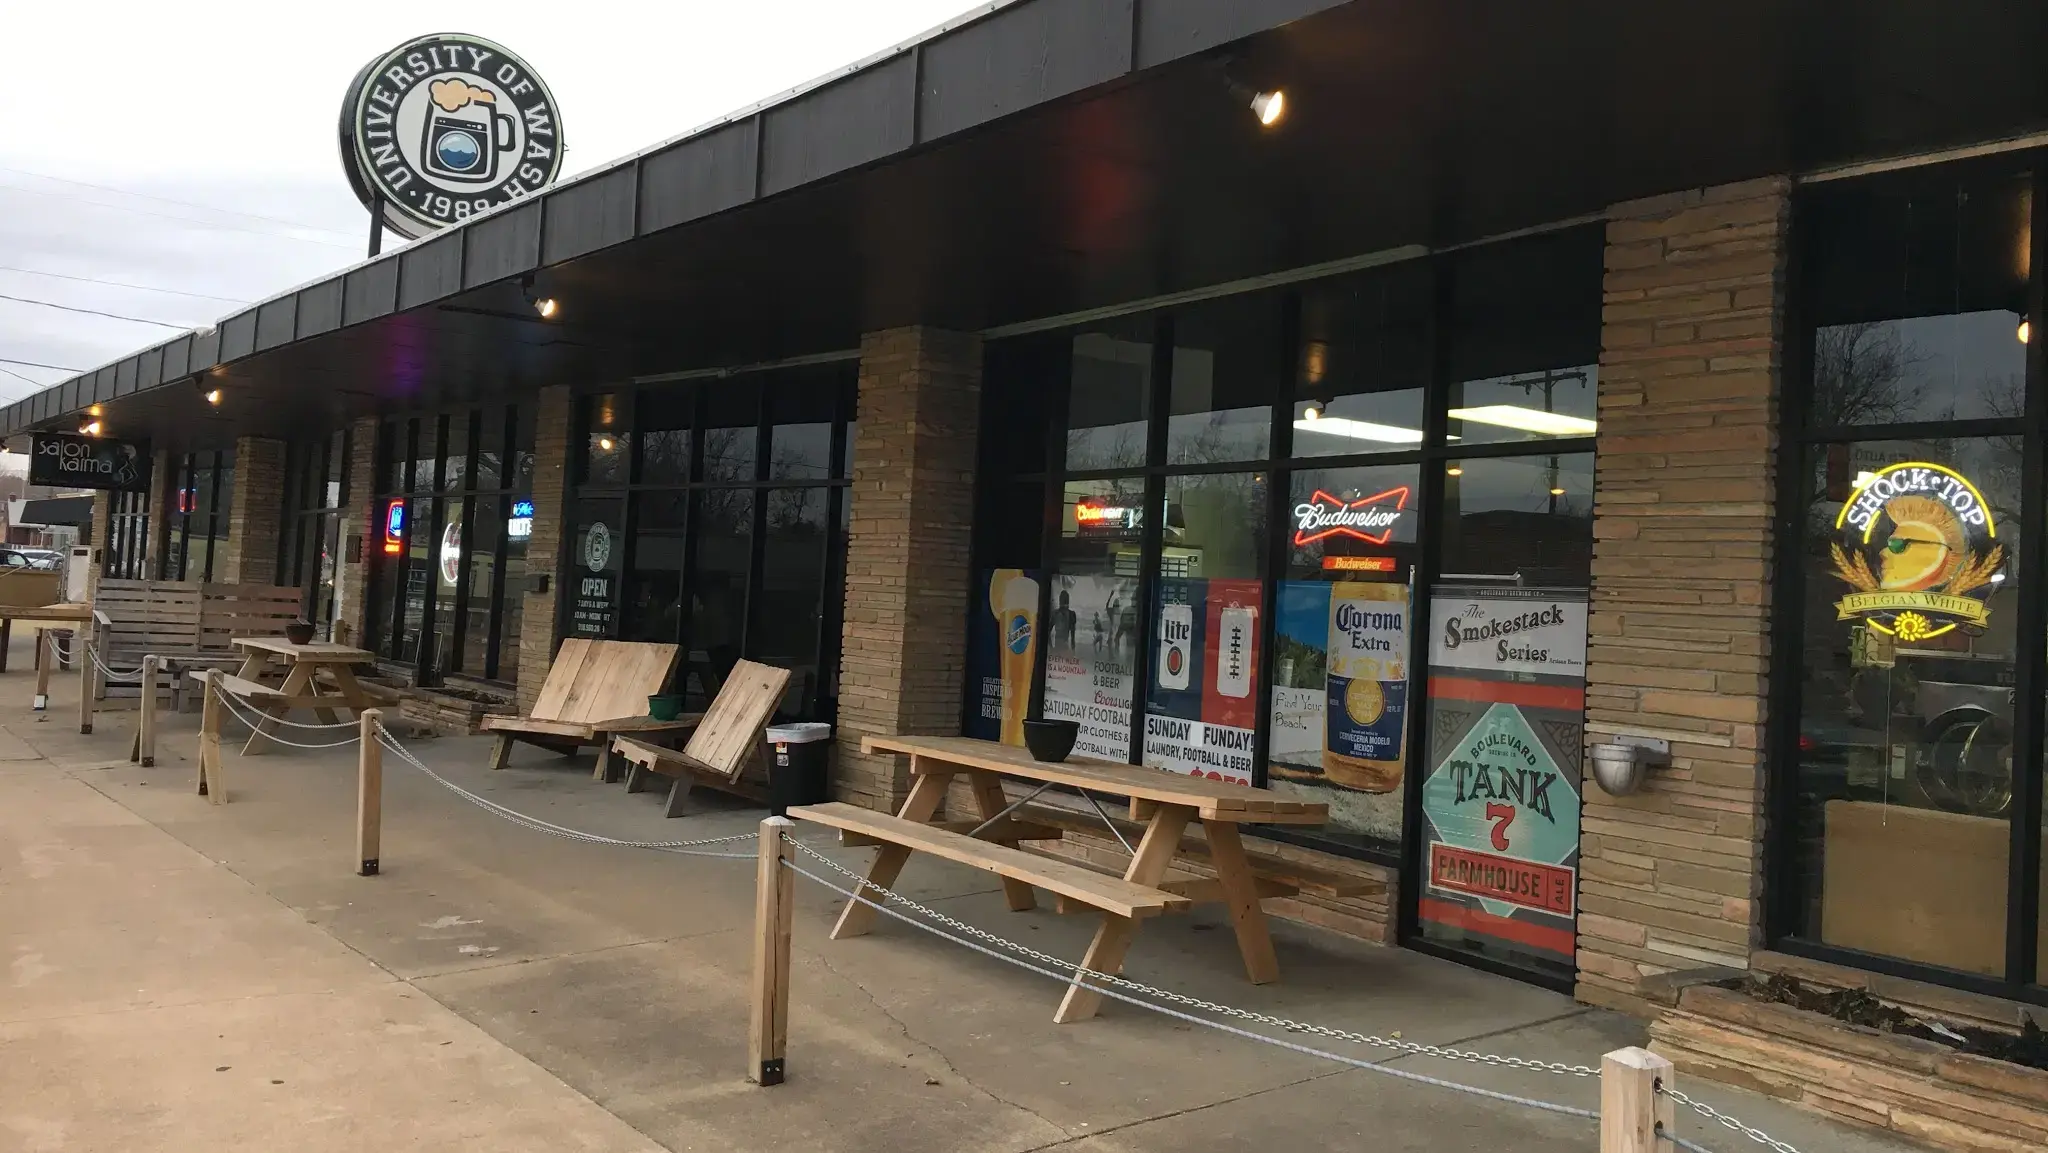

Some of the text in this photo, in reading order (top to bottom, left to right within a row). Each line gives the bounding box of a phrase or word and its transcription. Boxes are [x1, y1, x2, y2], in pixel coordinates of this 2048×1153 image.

[366, 45, 553, 200] UNIVERSITY OF WASH
[39, 439, 90, 457] salon
[1847, 468, 1985, 531] SHOCK TOP
[1295, 504, 1400, 529] Budweiser
[1334, 557, 1382, 570] Budweiser
[581, 578, 608, 597] OPEN
[1461, 604, 1486, 619] The
[1850, 594, 1975, 614] BELGIAN WHITE
[1335, 604, 1403, 635] Corona
[1444, 604, 1565, 649] Smokestack
[1164, 619, 1190, 645] Lite
[1351, 630, 1390, 652] Extra
[1496, 639, 1548, 662] Series
[1094, 661, 1133, 676] FOOTBALL
[1093, 675, 1120, 689] & BEER
[1043, 699, 1088, 720] SATURDAY
[1094, 690, 1118, 708] Coors
[1275, 692, 1322, 712] Find Your
[1275, 712, 1307, 730] Beach.
[1079, 725, 1129, 743] UR CLOTHES &
[1147, 717, 1254, 752] SUNDAY FUNDAY!
[1076, 741, 1128, 760] OOTBALL WITH
[1146, 740, 1181, 761] LAUNDRY,
[1182, 747, 1221, 767] FOOTBALL
[1223, 754, 1229, 768] &
[1230, 755, 1252, 772] BEER
[1353, 743, 1374, 753] MEXICO
[1470, 733, 1537, 766] BOULEVARD
[1450, 759, 1557, 825] TANK
[1486, 801, 1516, 851] 7
[1438, 854, 1541, 898] FARMHOUSE
[1555, 878, 1565, 905] ALE
